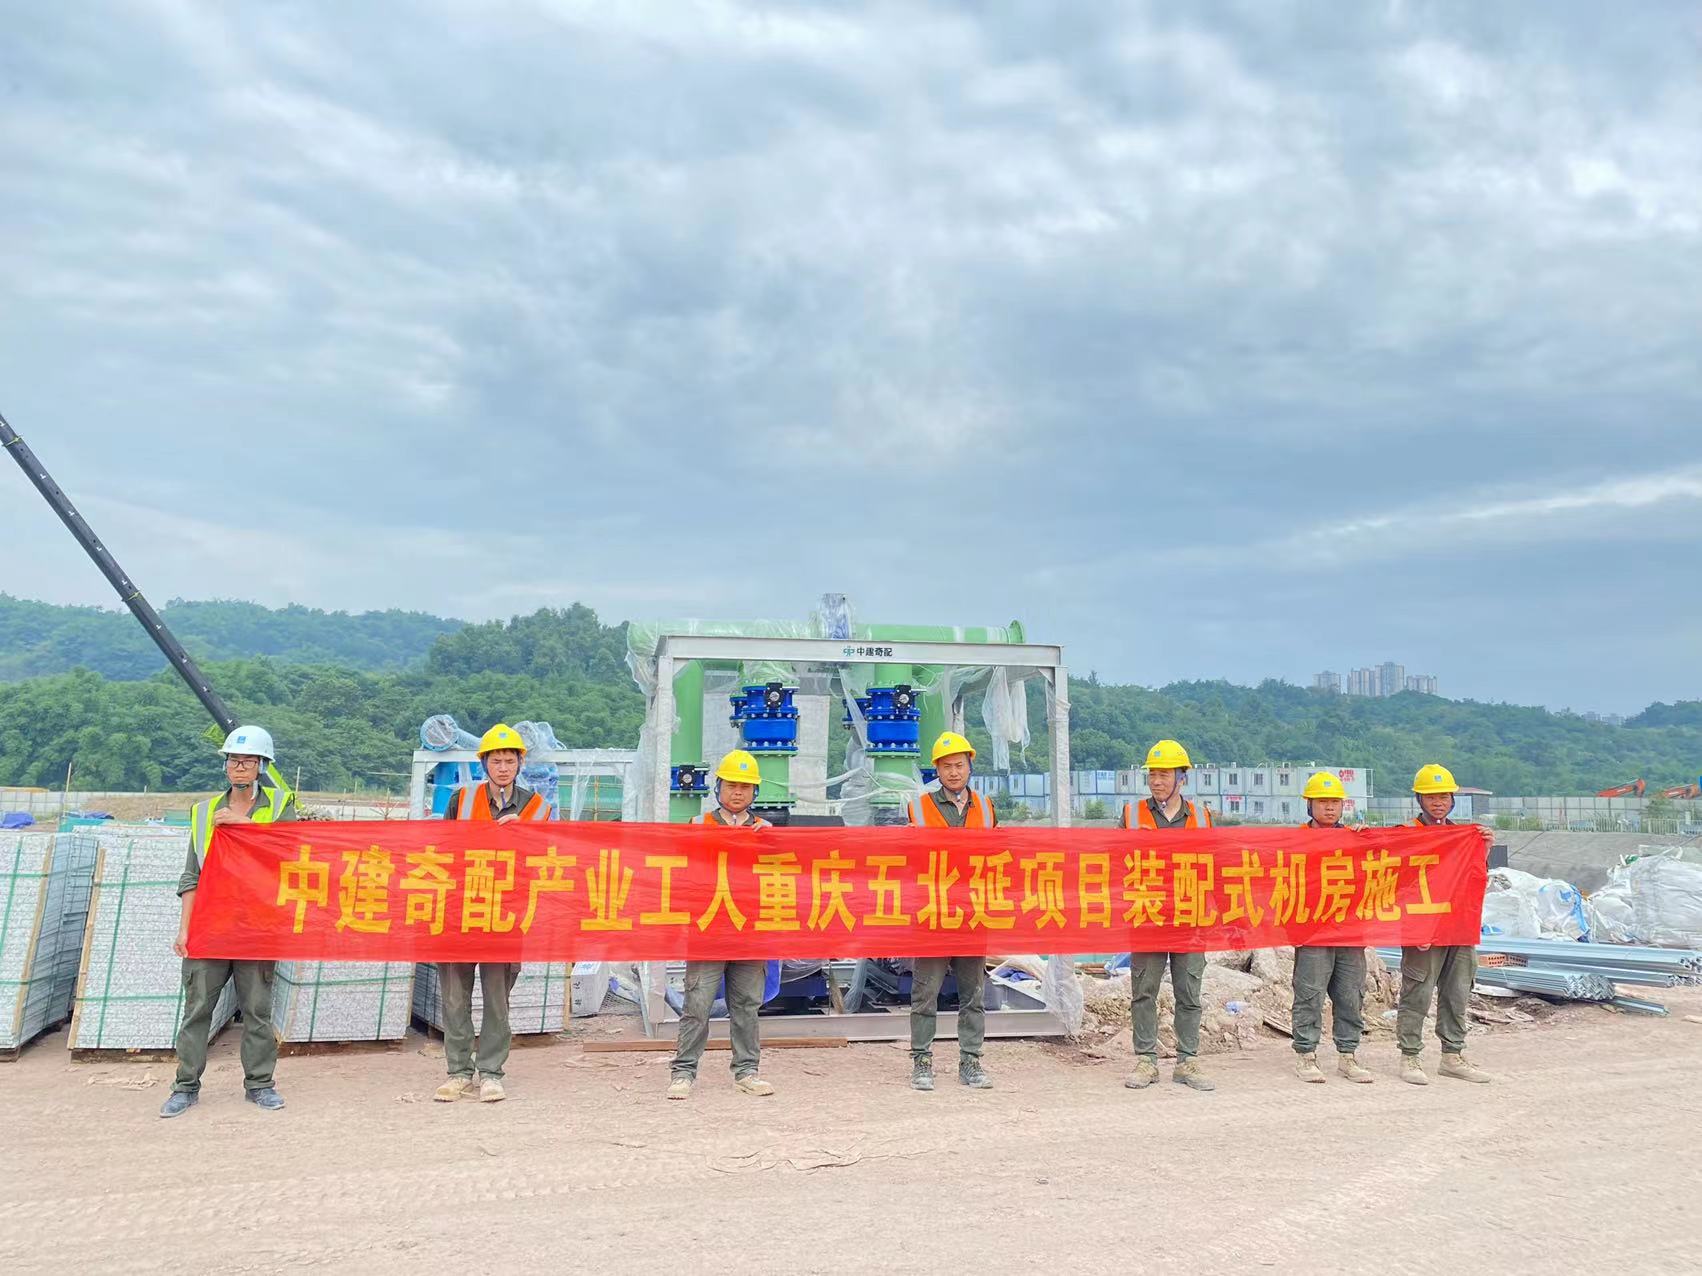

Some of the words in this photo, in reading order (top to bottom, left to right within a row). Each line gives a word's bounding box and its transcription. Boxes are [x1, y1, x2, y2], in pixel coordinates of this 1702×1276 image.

[856, 646, 893, 657] 中建奇配
[276, 844, 1451, 935] 中建奇配产业工人重庆五北延项目装配式机房施工
